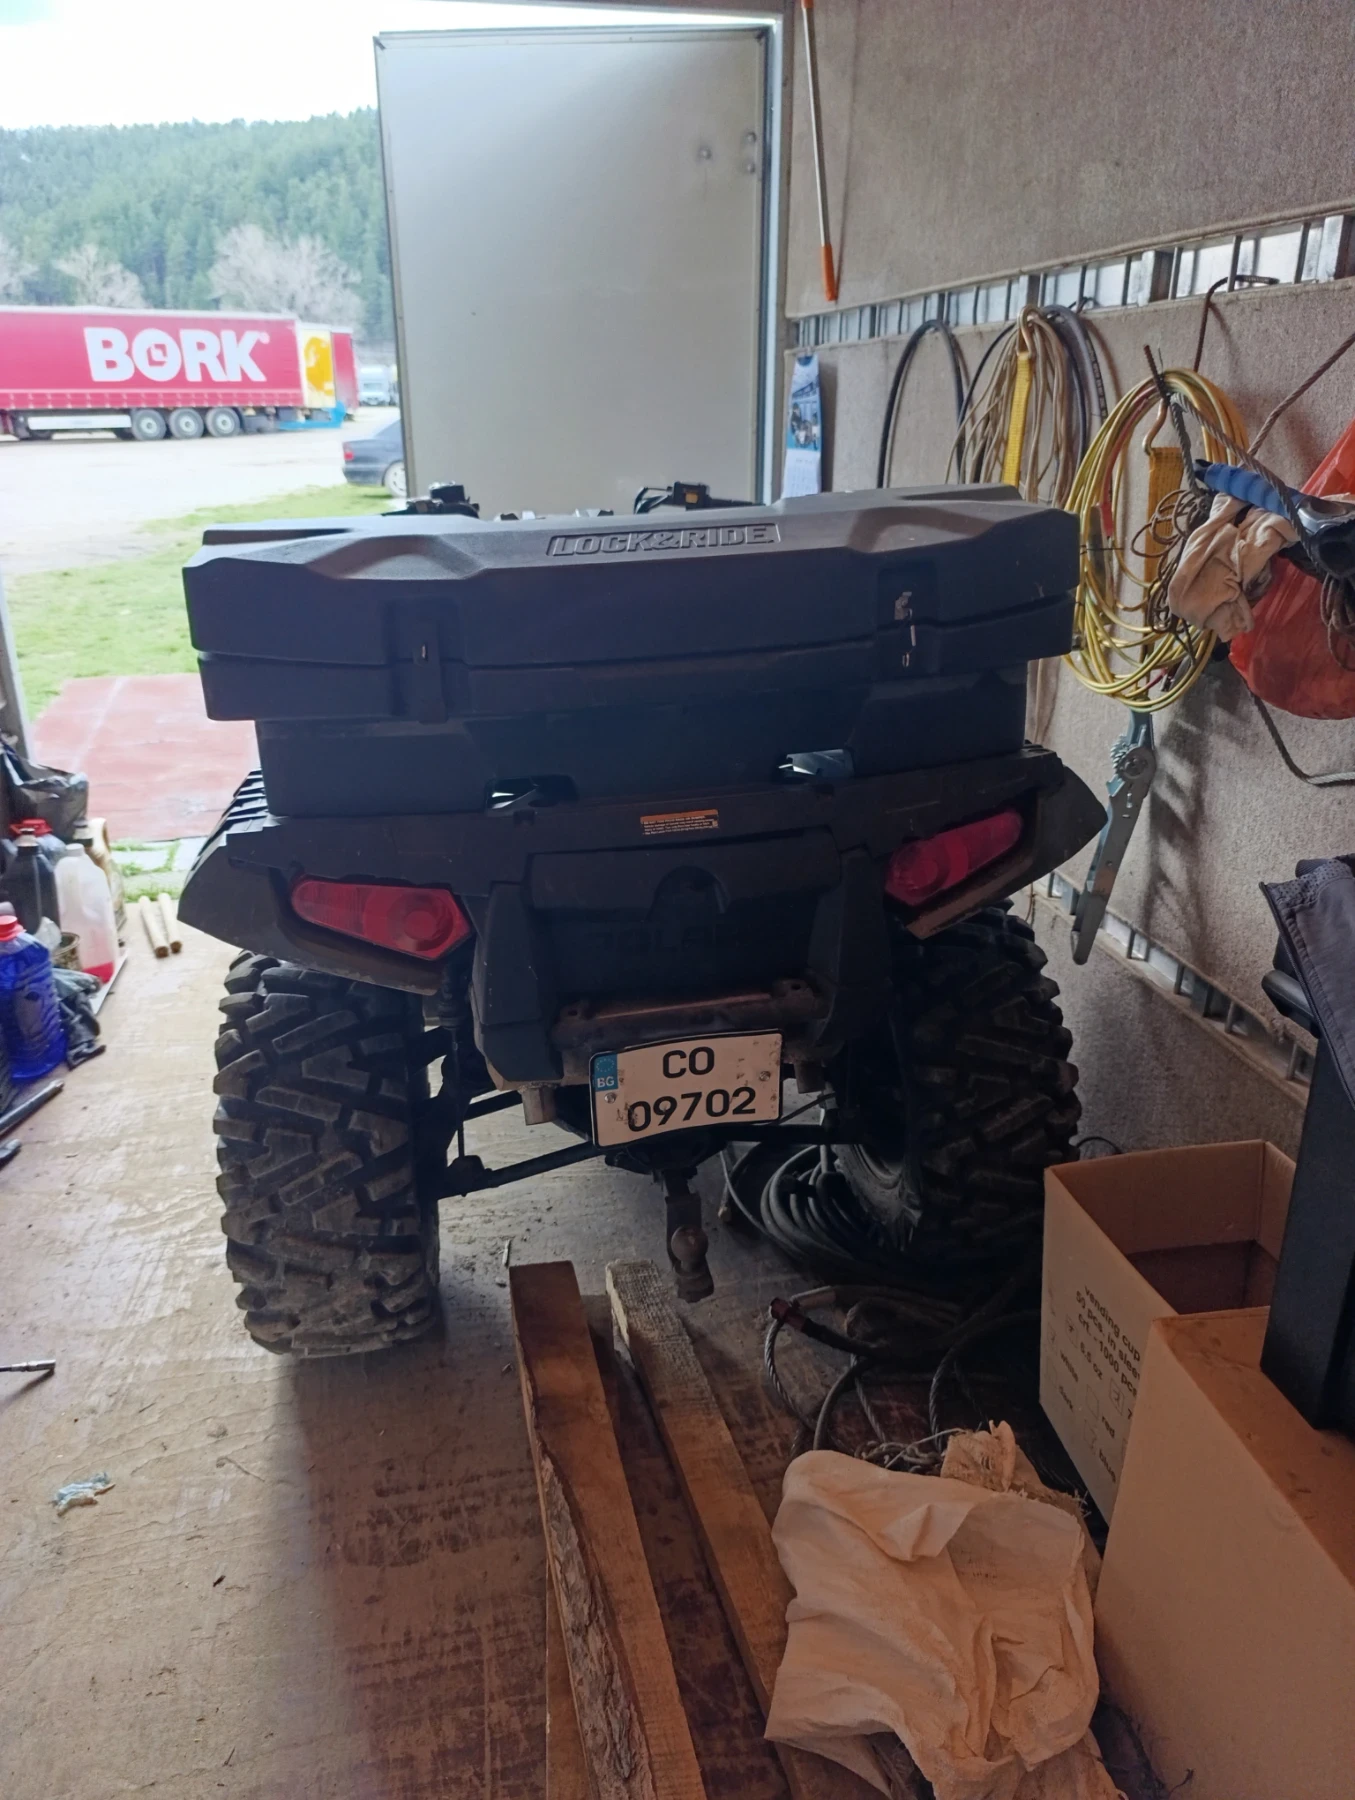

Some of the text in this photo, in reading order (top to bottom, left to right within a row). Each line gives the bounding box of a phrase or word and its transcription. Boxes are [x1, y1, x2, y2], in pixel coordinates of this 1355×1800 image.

[84, 327, 267, 383] BORK
[596, 1076, 615, 1089] BG
[662, 1046, 715, 1079] CO
[627, 1086, 756, 1132] 09702
[1076, 1290, 1086, 1309] 50
[1108, 1332, 1116, 1351] in
[1085, 1284, 1120, 1338] vending
[1102, 1415, 1116, 1438] red
[1099, 1448, 1116, 1484] blue
